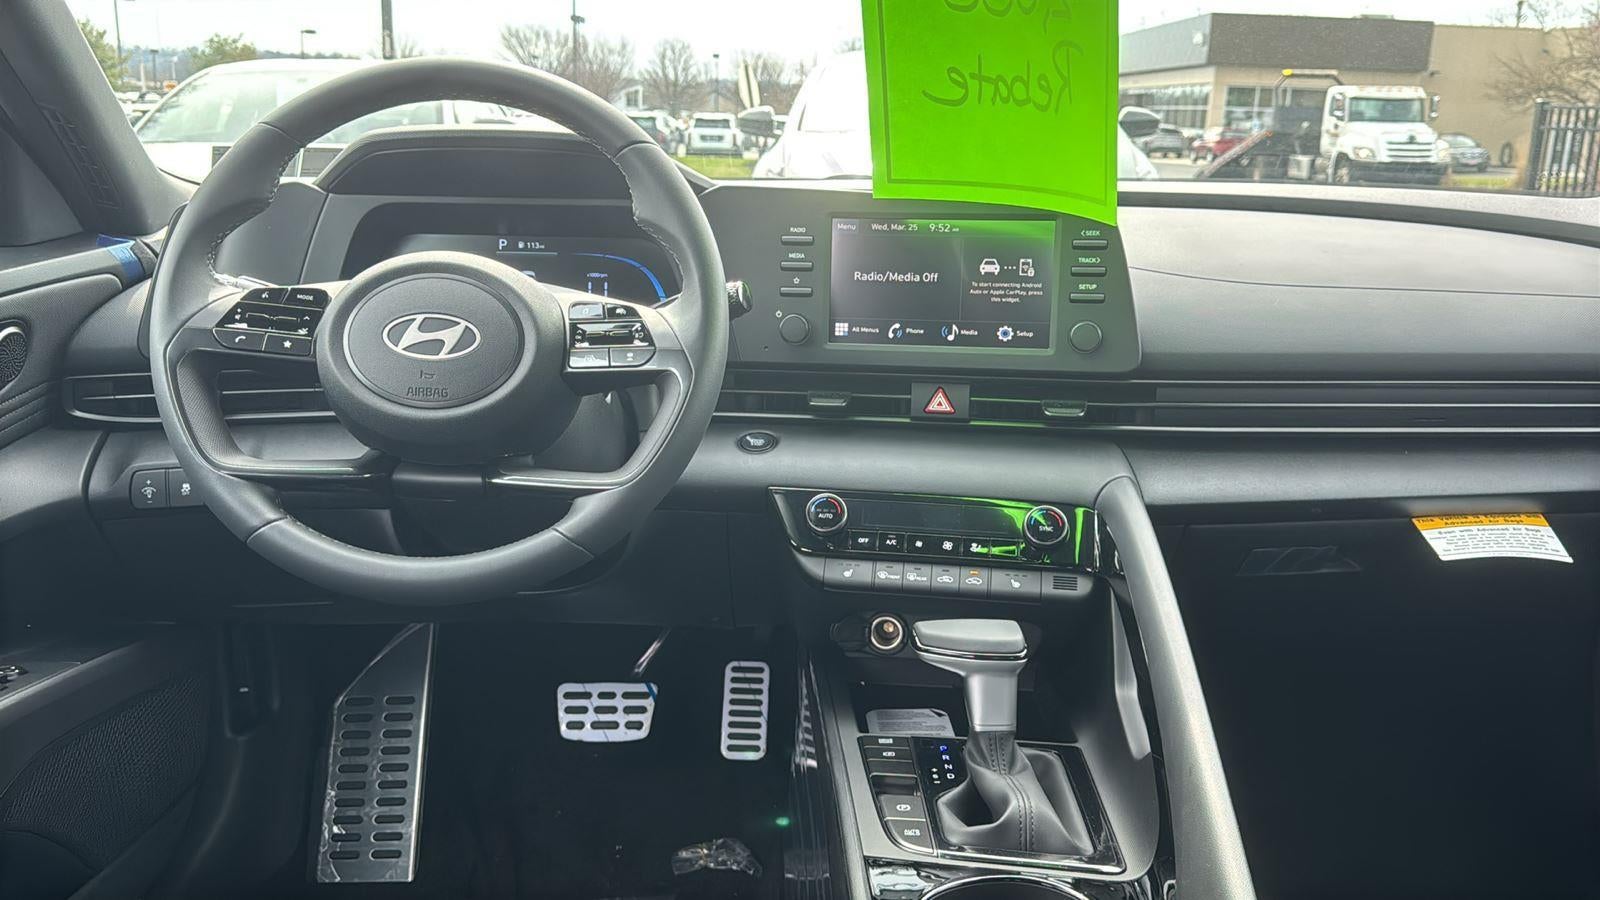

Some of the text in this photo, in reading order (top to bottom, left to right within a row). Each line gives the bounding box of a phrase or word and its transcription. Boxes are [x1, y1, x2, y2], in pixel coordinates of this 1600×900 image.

[837, 223, 856, 231] Menu
[891, 223, 906, 231] Mar.
[908, 223, 918, 231] 25
[929, 223, 951, 232] 9:52
[499, 238, 508, 250] P
[854, 271, 939, 282] Radio/Media Off
[860, 326, 879, 334] Menus
[906, 327, 924, 335] Phone
[1016, 330, 1034, 338] Setup
[406, 386, 449, 398] AIRBAG
